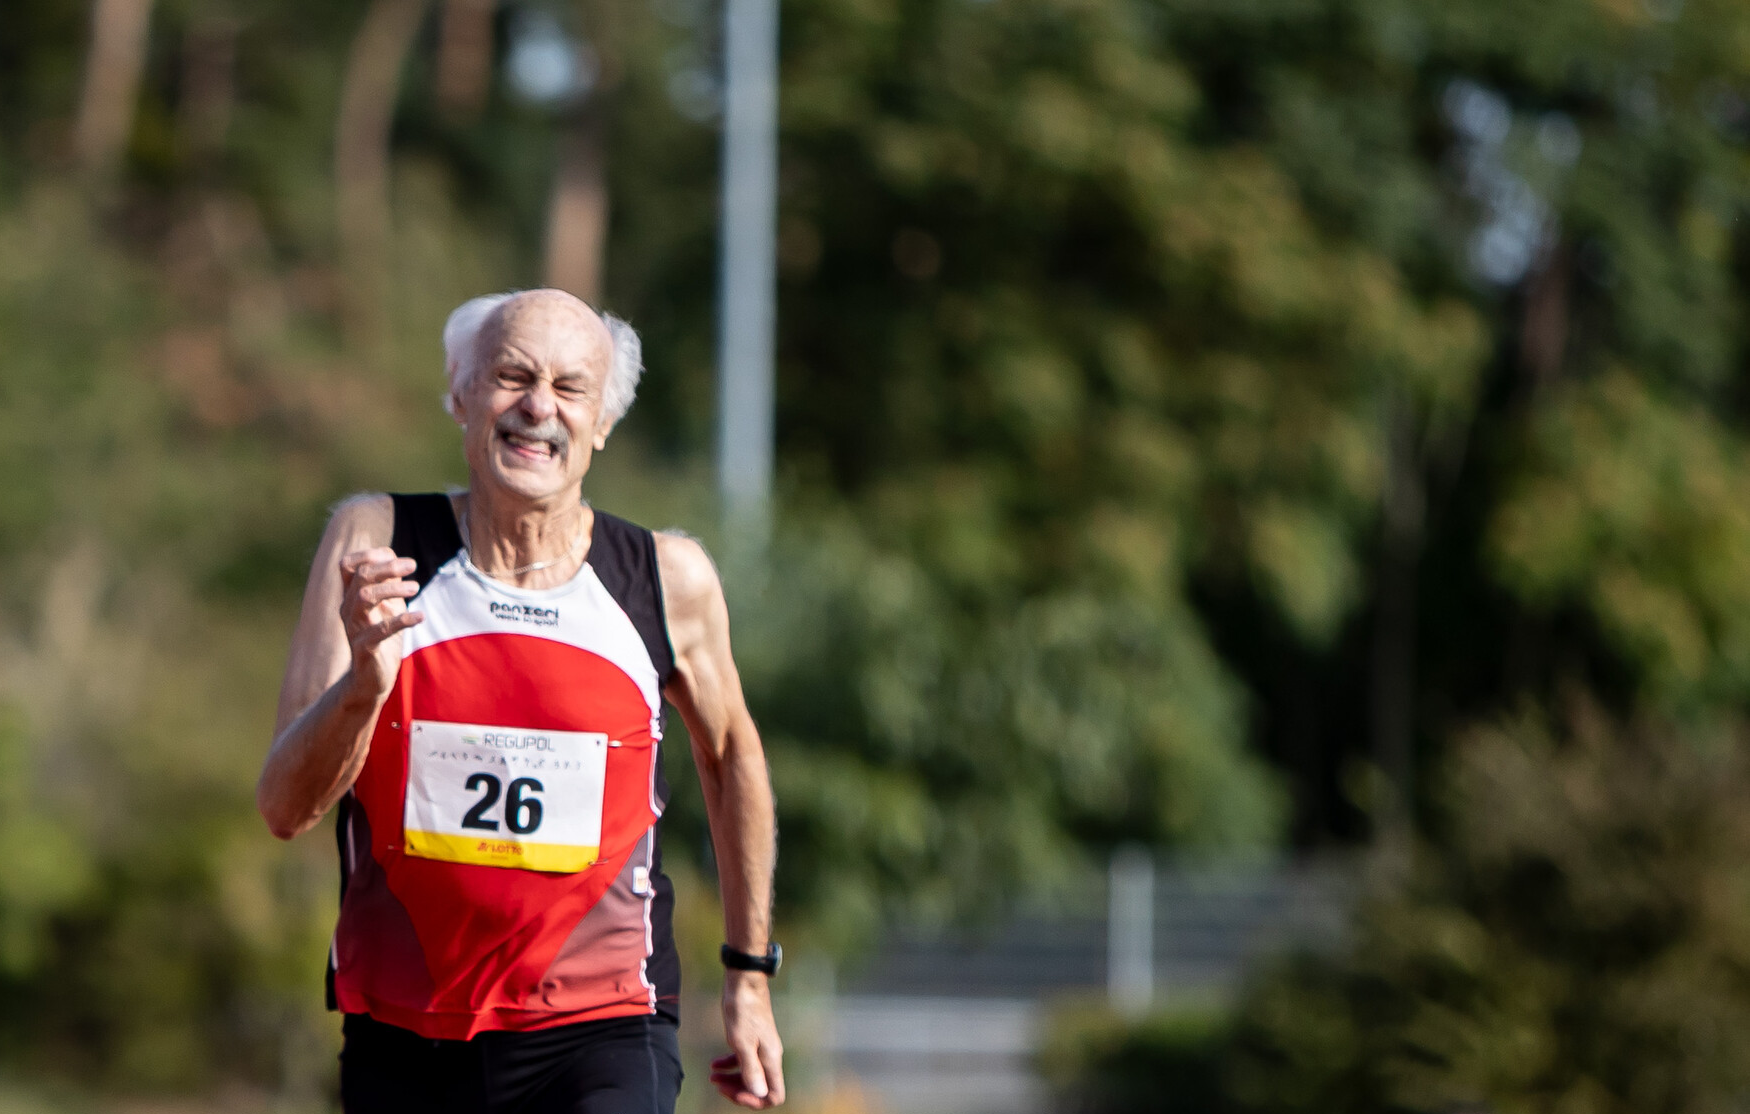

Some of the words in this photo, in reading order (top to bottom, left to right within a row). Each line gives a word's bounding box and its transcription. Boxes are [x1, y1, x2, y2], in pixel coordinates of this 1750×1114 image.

[490, 601, 559, 618] panzeri
[483, 732, 555, 752] REGUPOL
[461, 772, 544, 835] 26
[491, 843, 524, 856] LOTTO
